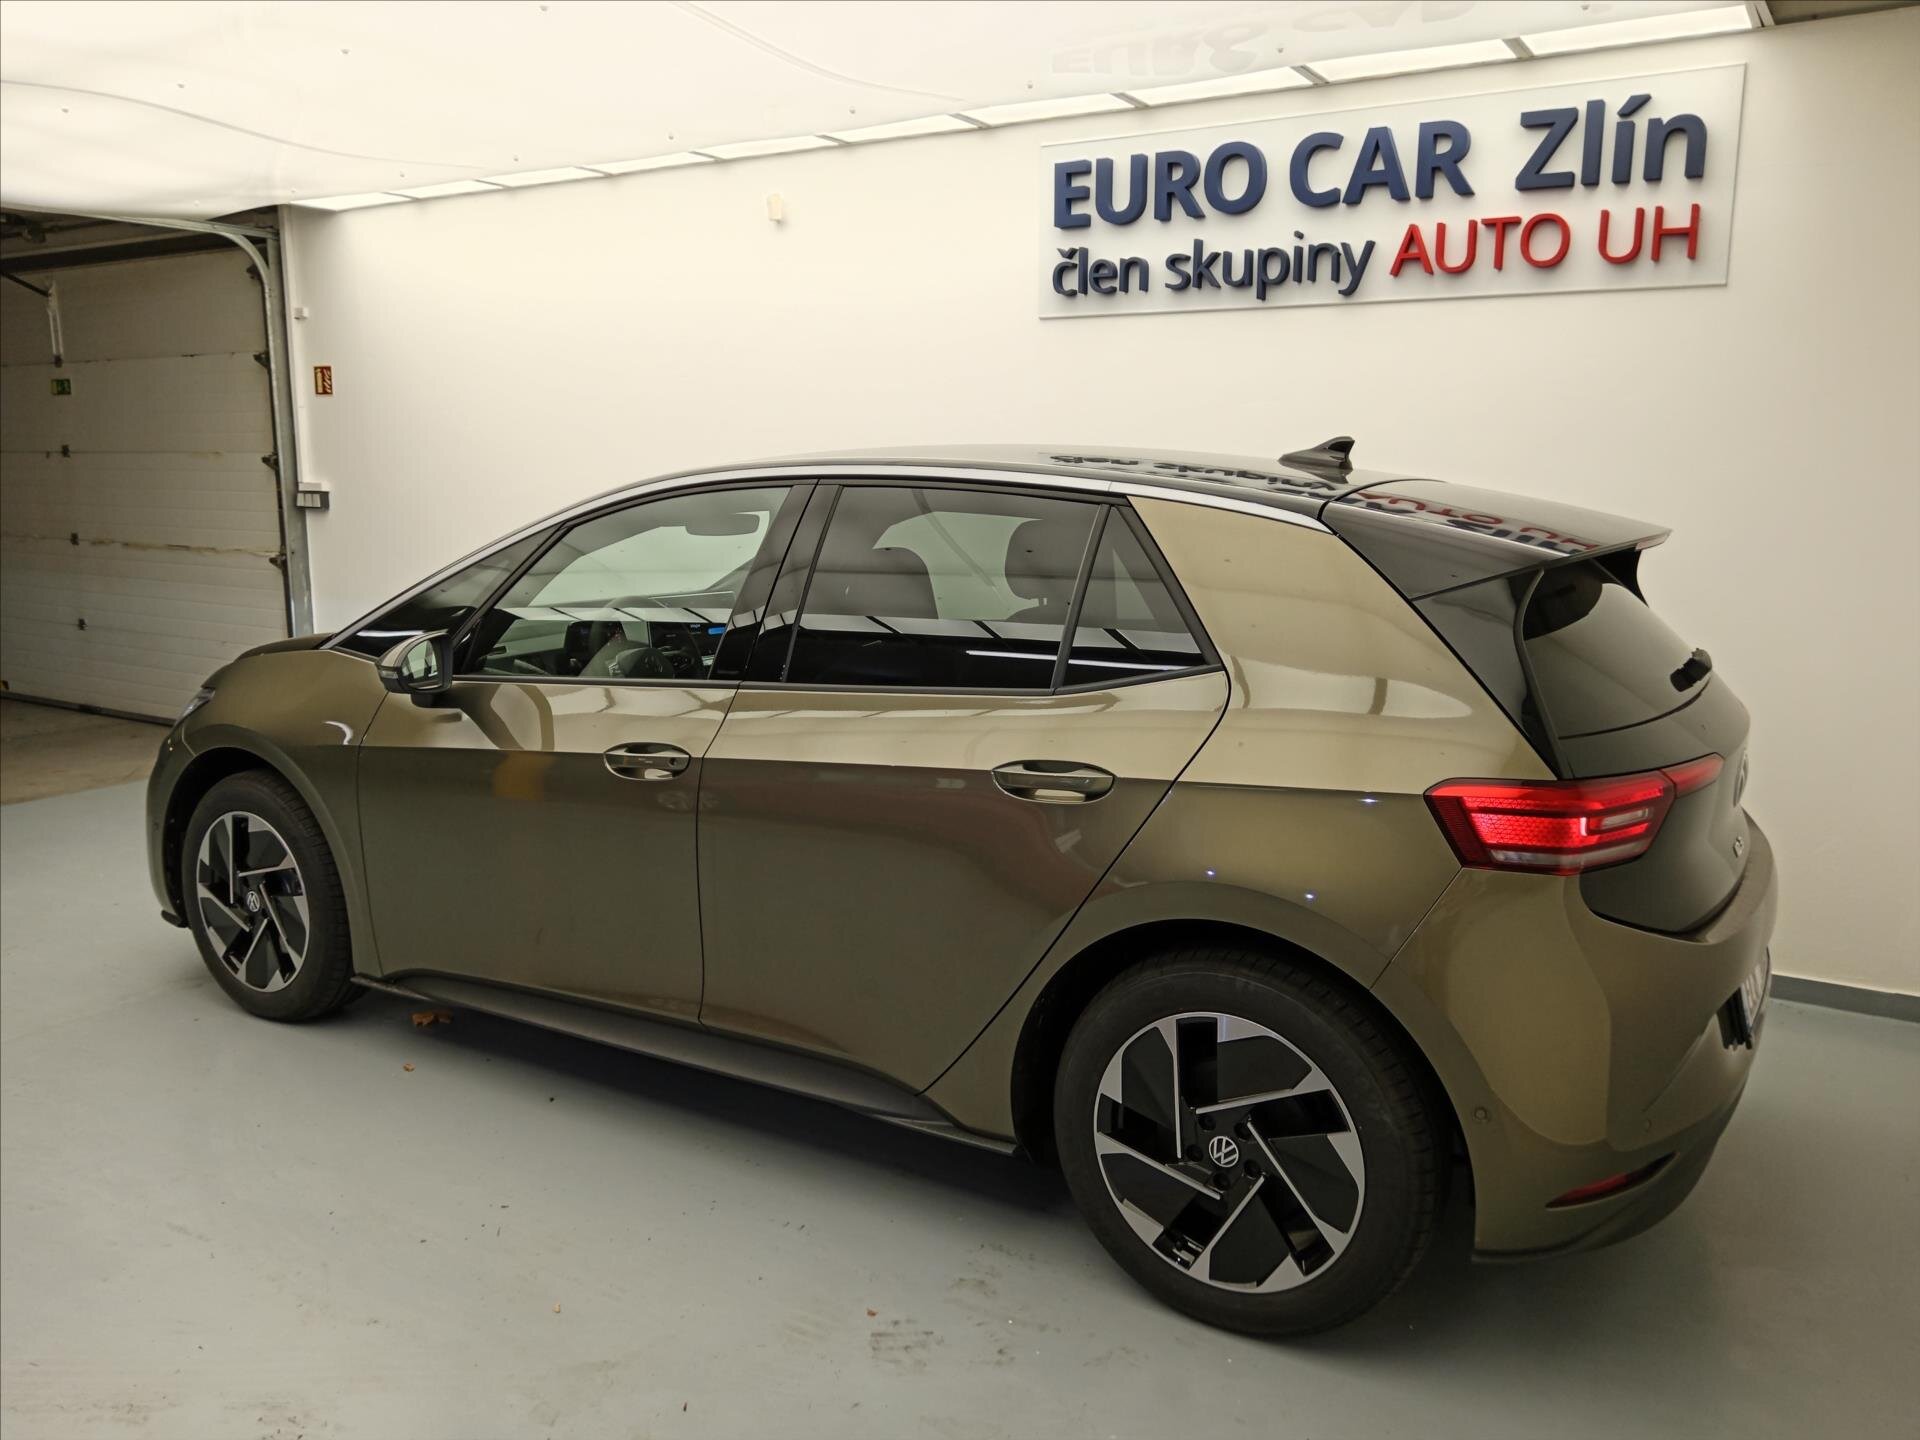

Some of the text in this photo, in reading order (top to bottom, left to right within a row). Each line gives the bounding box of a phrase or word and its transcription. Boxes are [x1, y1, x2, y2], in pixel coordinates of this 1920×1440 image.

[1052, 94, 1708, 231] EURO CAR Zlín
[1052, 203, 1701, 303] člen skupiny AUTO UH
[1208, 1136, 1239, 1167] VW
